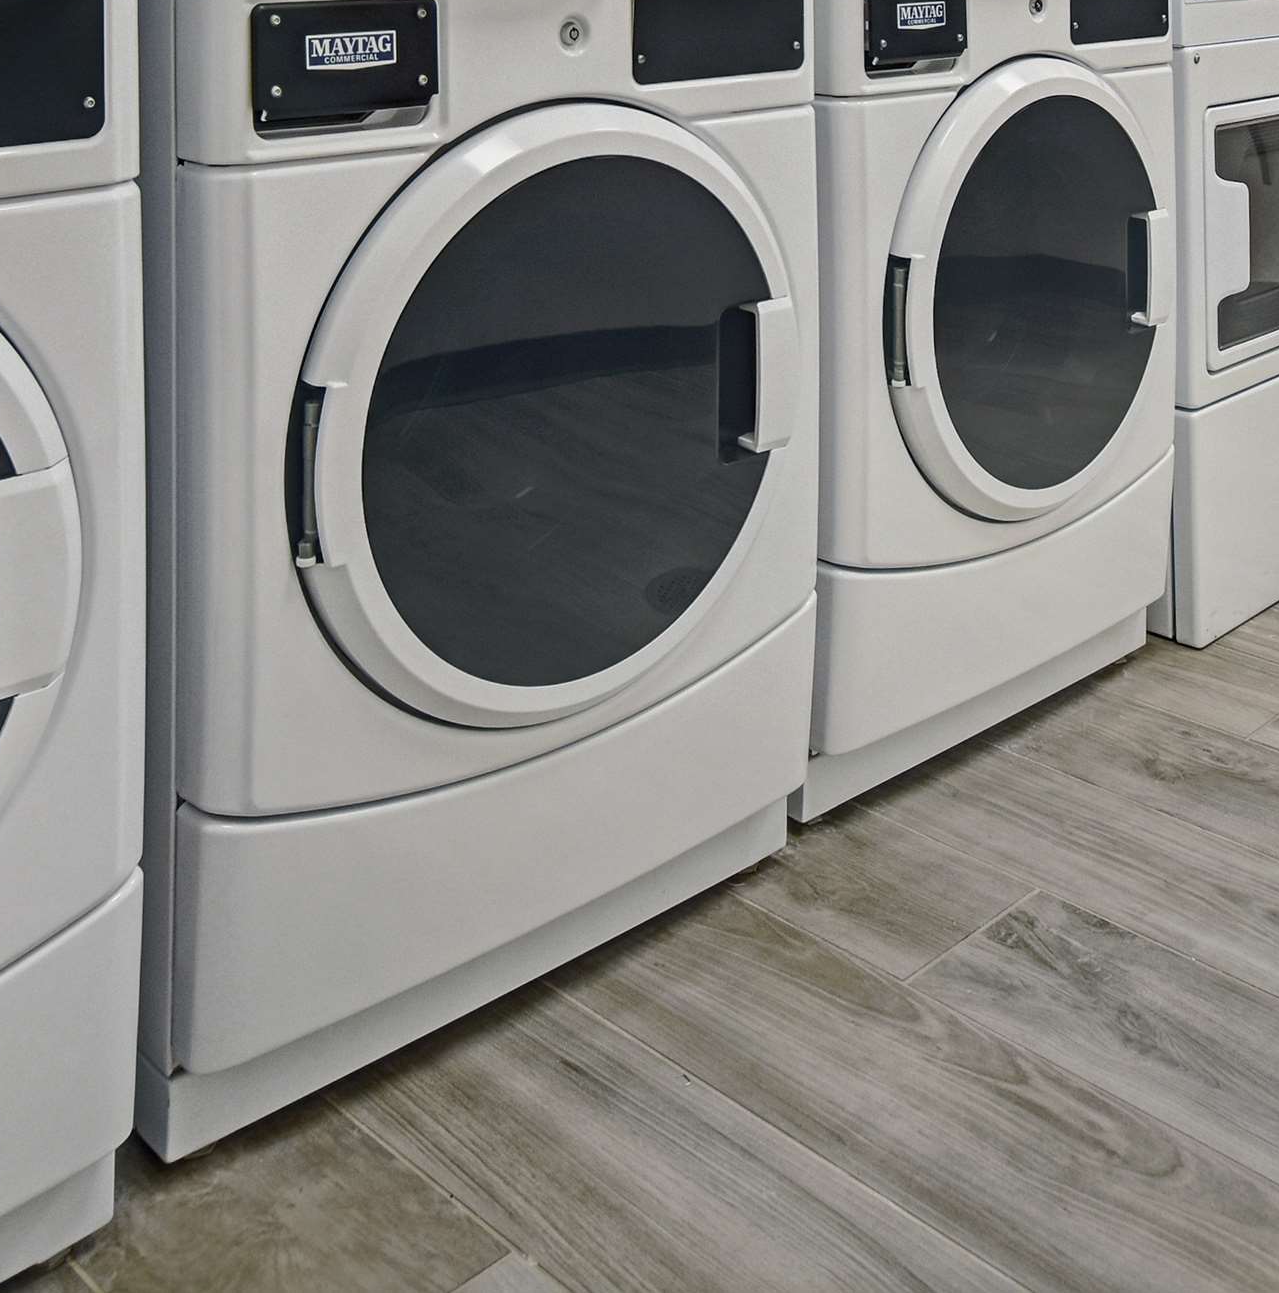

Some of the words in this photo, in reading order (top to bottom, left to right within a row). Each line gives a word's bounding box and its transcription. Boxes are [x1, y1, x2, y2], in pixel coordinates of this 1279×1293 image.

[900, 4, 943, 21] MAYTAG
[310, 34, 392, 58] MAYTAG
[323, 52, 380, 65] COMMERCIAL
